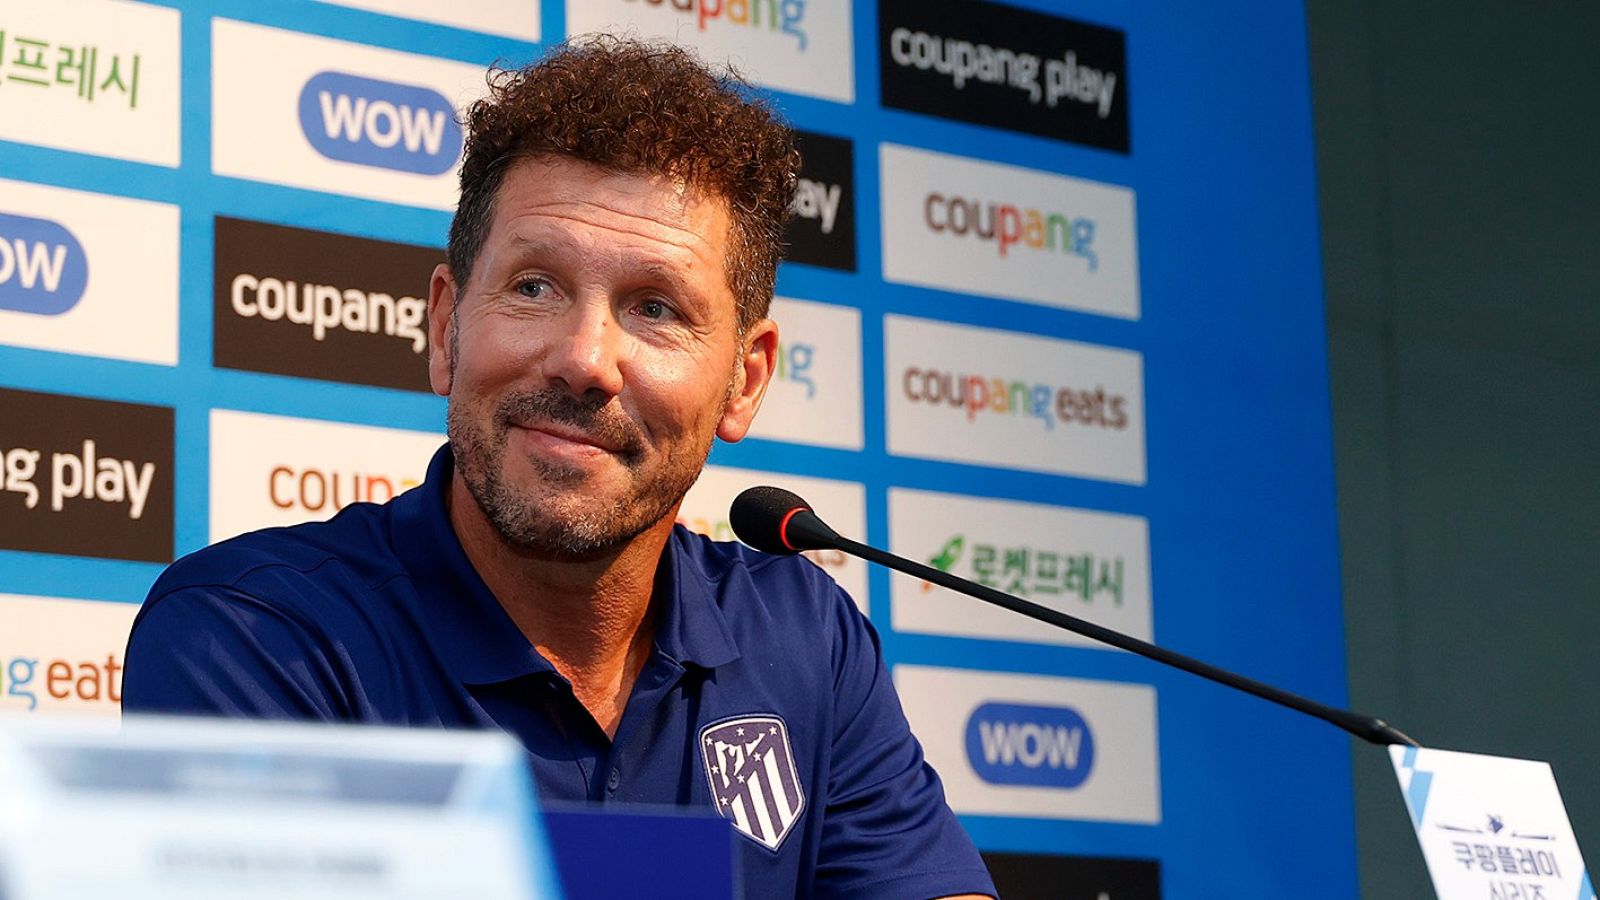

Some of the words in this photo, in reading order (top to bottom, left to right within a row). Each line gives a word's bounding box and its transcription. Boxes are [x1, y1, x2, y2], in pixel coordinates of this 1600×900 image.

[620, 0, 808, 51] pang
[0, 30, 140, 109] 프레시
[890, 27, 1042, 103] coupang
[1044, 50, 1116, 119] play
[318, 90, 447, 156] WOW
[790, 178, 842, 234] ay
[924, 191, 1097, 273] coupang
[230, 273, 427, 354] coupang
[902, 366, 1055, 431] coupang
[1055, 385, 1128, 430] eats
[51, 438, 156, 520] play
[971, 543, 1125, 608] 로켓프레시
[977, 720, 1083, 771] WOW
[1452, 840, 1563, 879] 쿠팡플레이
